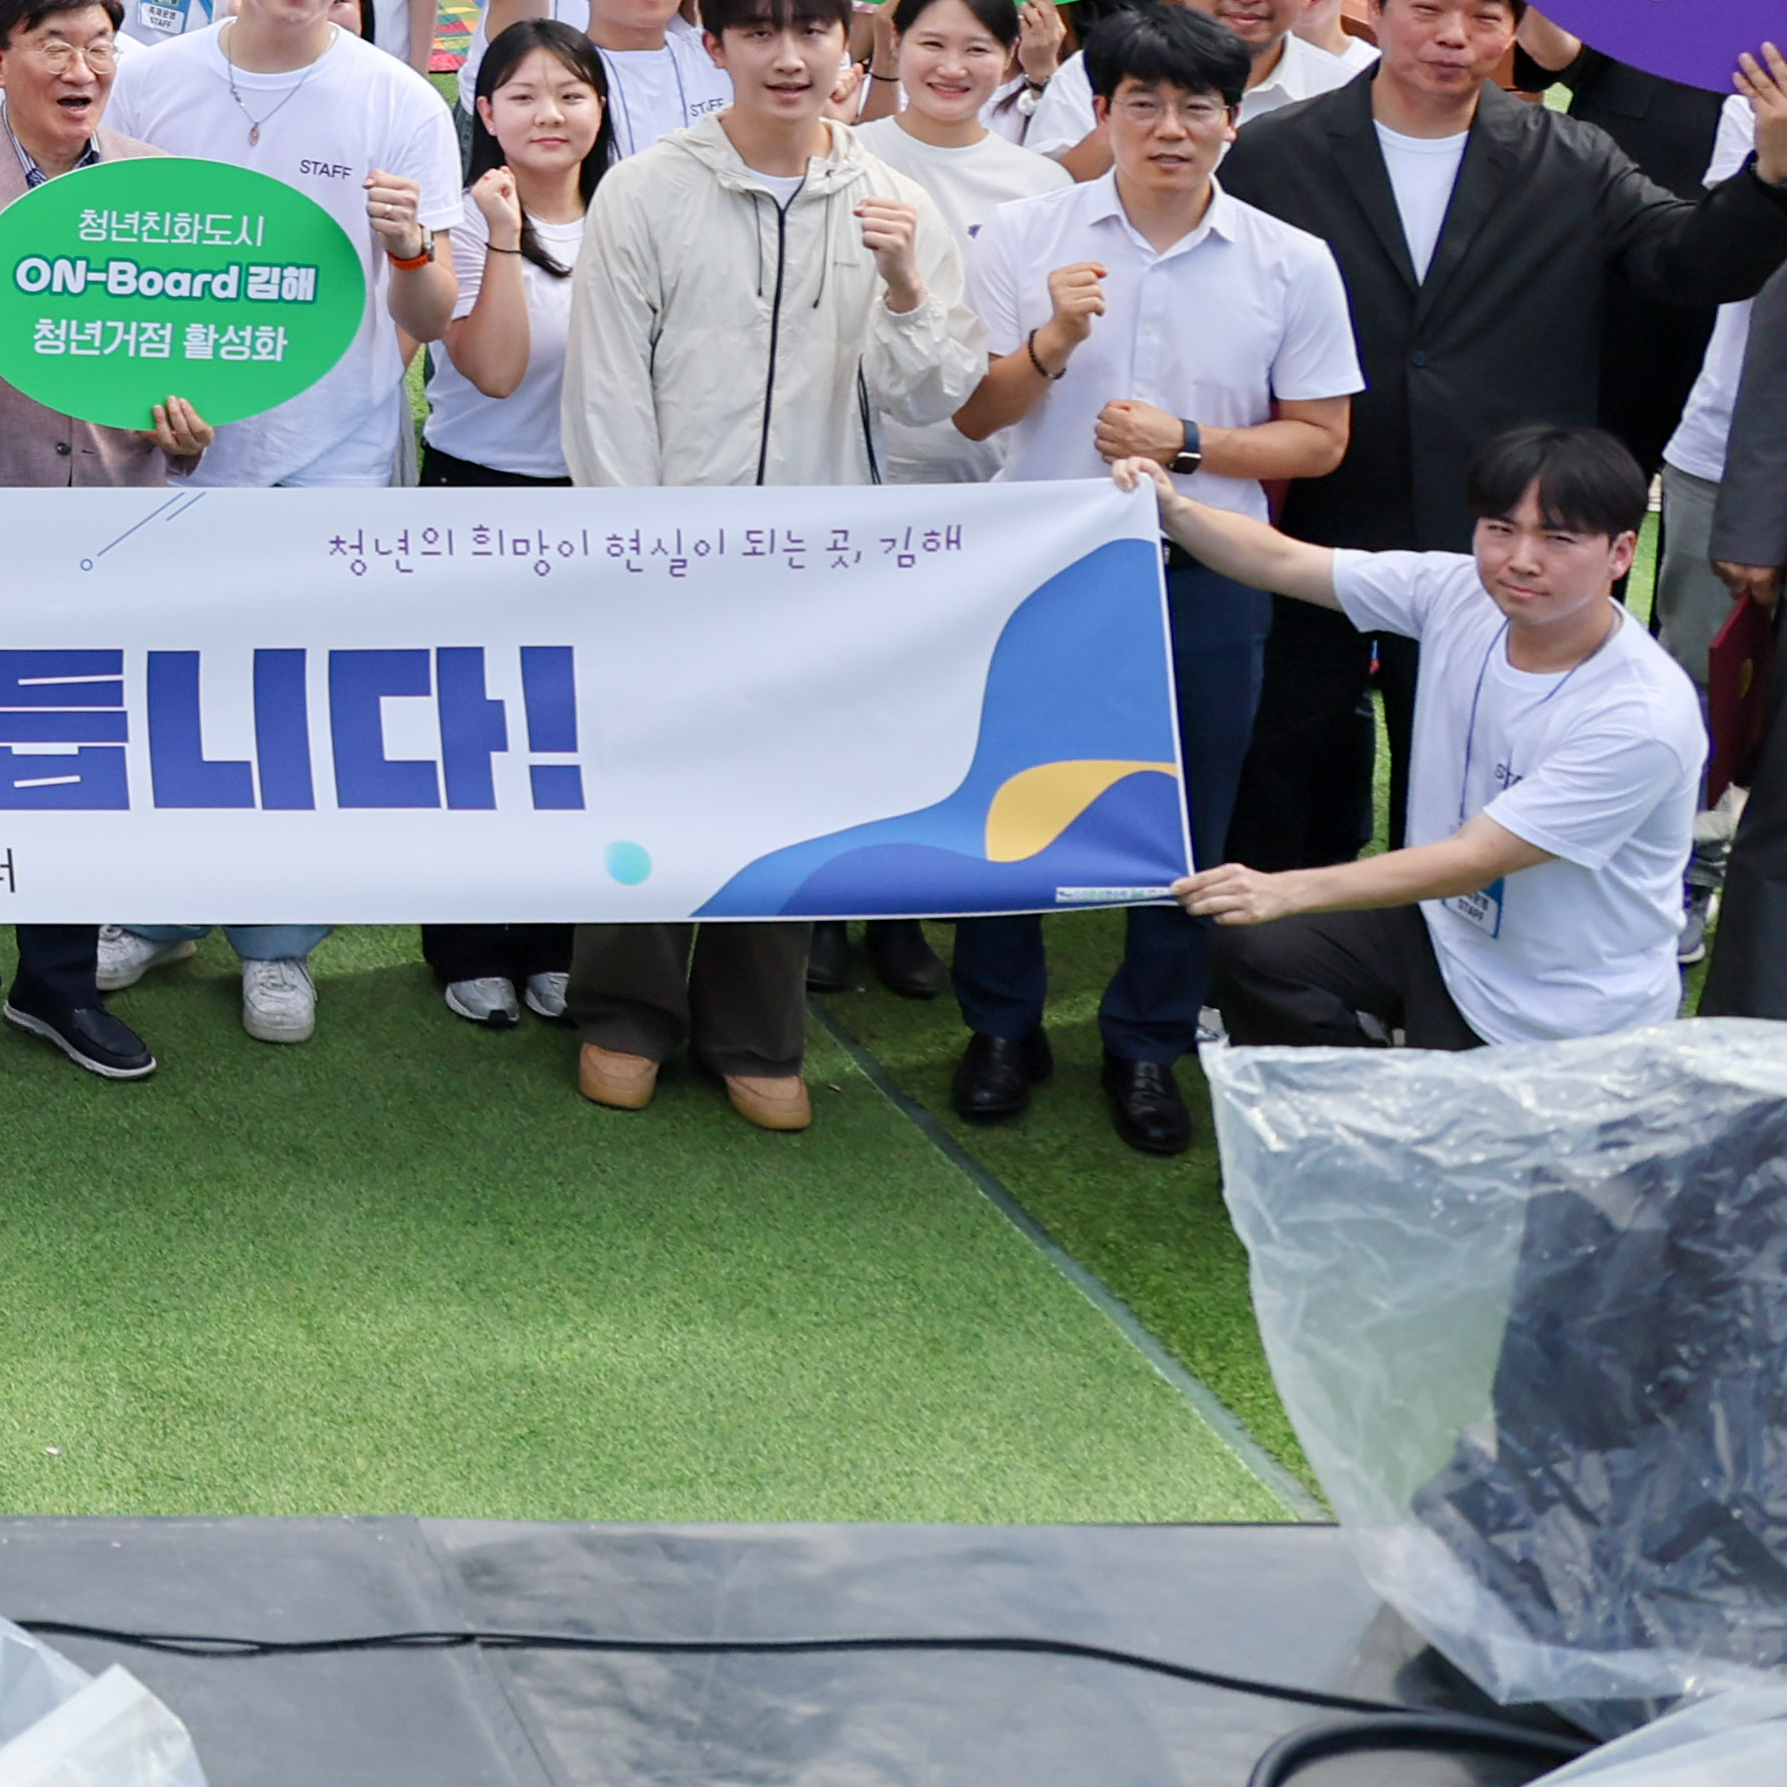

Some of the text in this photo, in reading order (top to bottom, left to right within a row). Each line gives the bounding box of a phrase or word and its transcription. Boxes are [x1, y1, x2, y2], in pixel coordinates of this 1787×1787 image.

[299, 158, 353, 182] STAFF
[78, 206, 265, 249] 청년친화도시
[15, 256, 316, 304] ON-Board 김해
[32, 317, 289, 364] 청년거점 활성화
[328, 528, 454, 578] 청년의
[470, 524, 589, 576] 희망이
[605, 527, 727, 578] 현실이
[741, 528, 808, 571] 되는
[878, 524, 964, 569] 김해
